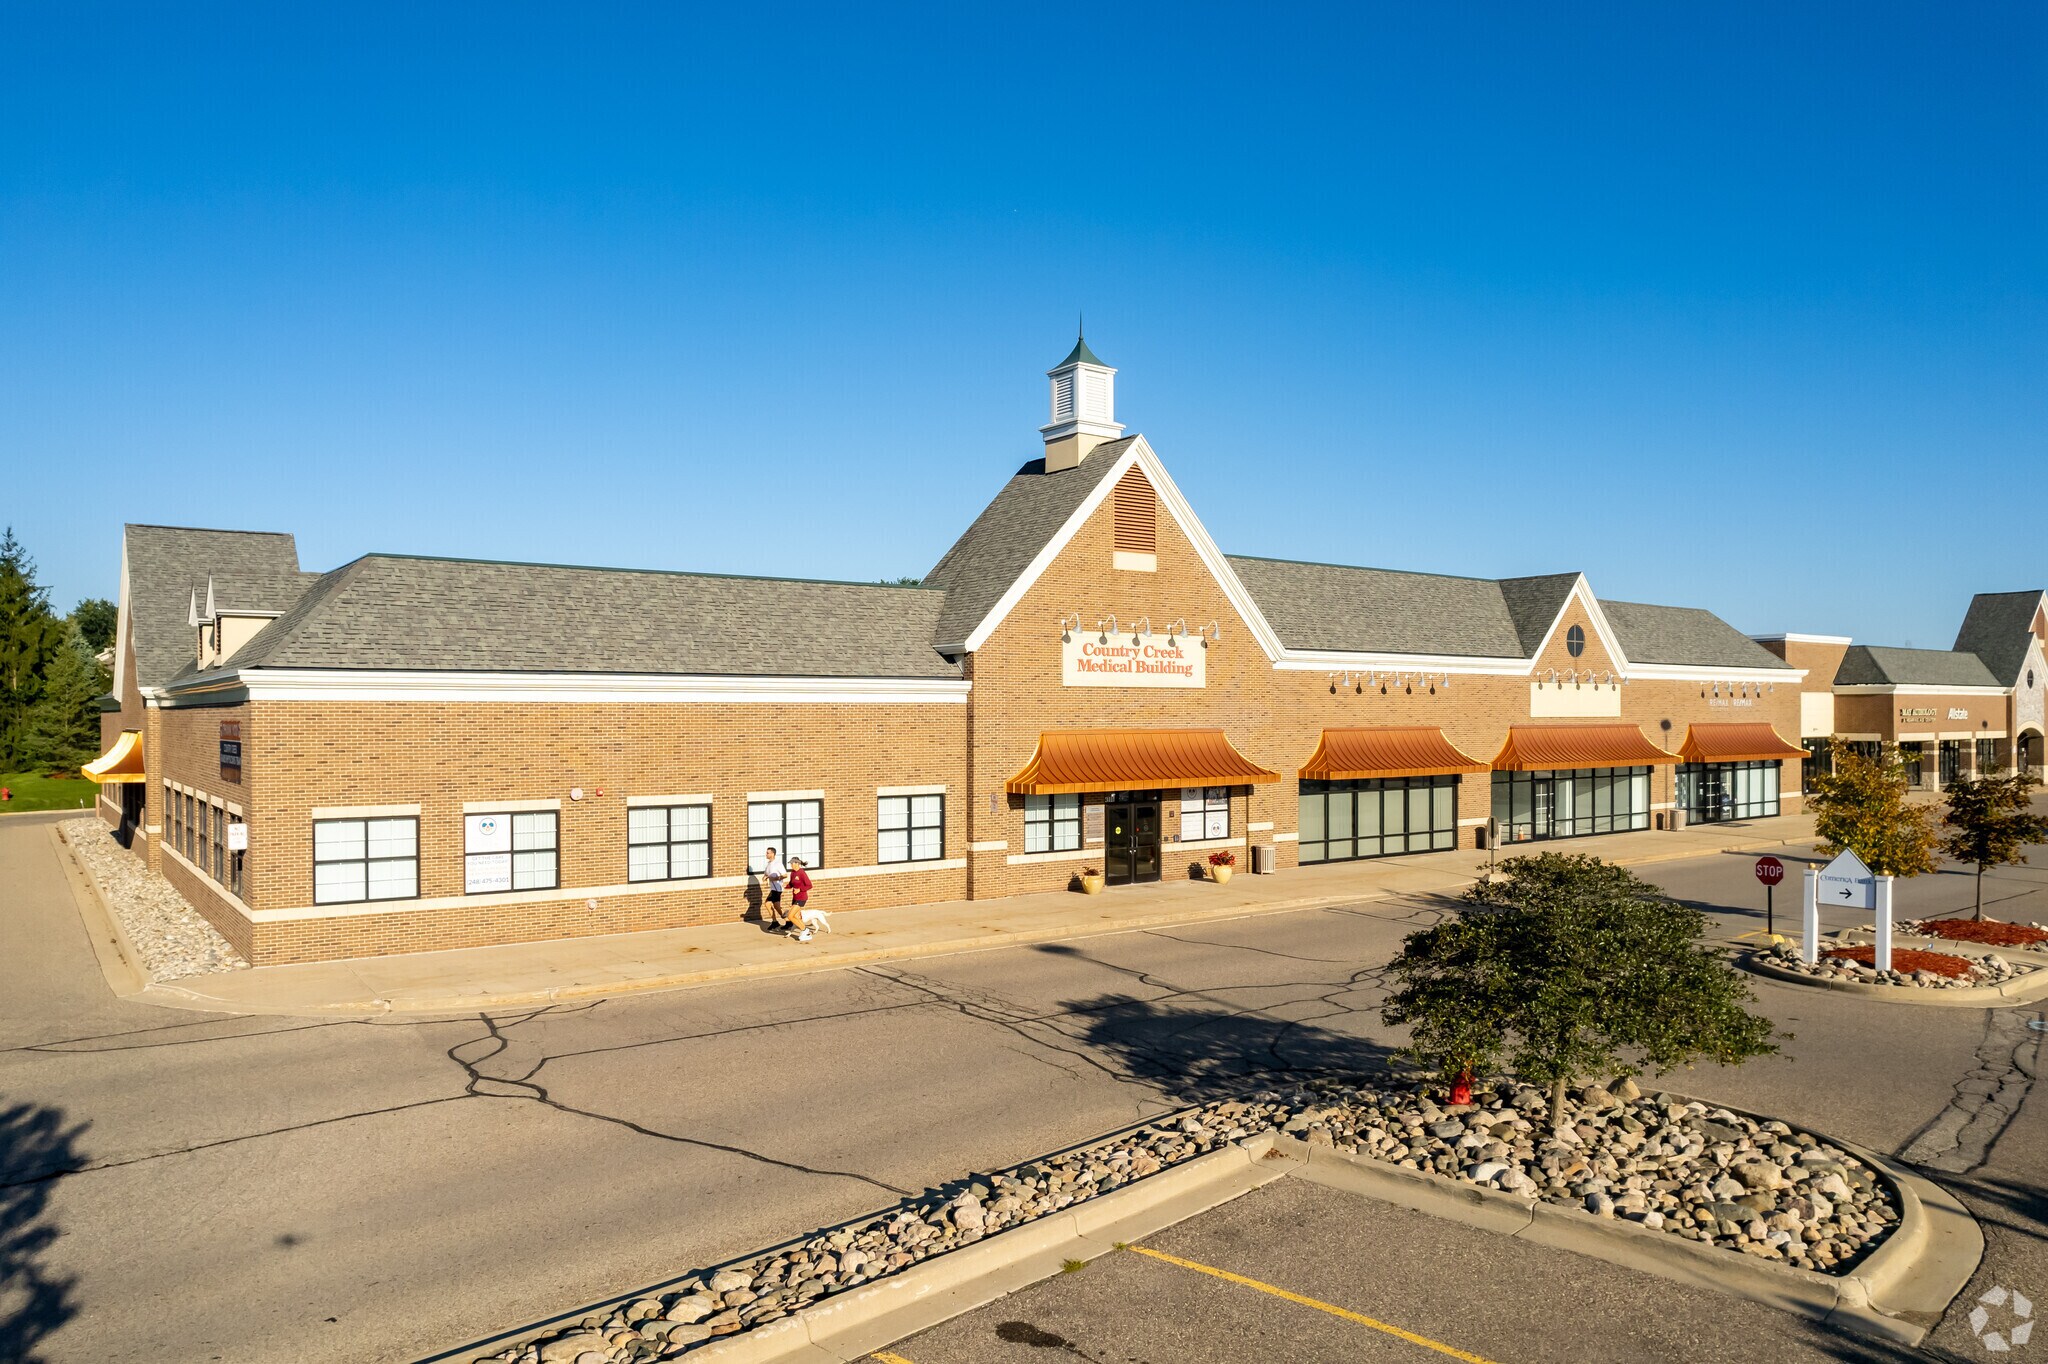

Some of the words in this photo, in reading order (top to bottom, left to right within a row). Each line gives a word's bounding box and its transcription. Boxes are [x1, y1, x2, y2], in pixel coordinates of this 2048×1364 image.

[1082, 643, 1140, 660] Country
[1143, 645, 1184, 659] Creek
[1077, 658, 1133, 673] Medical
[1135, 660, 1193, 677] Building
[1947, 707, 1968, 720] Allstate
[1756, 864, 1783, 877] STOP
